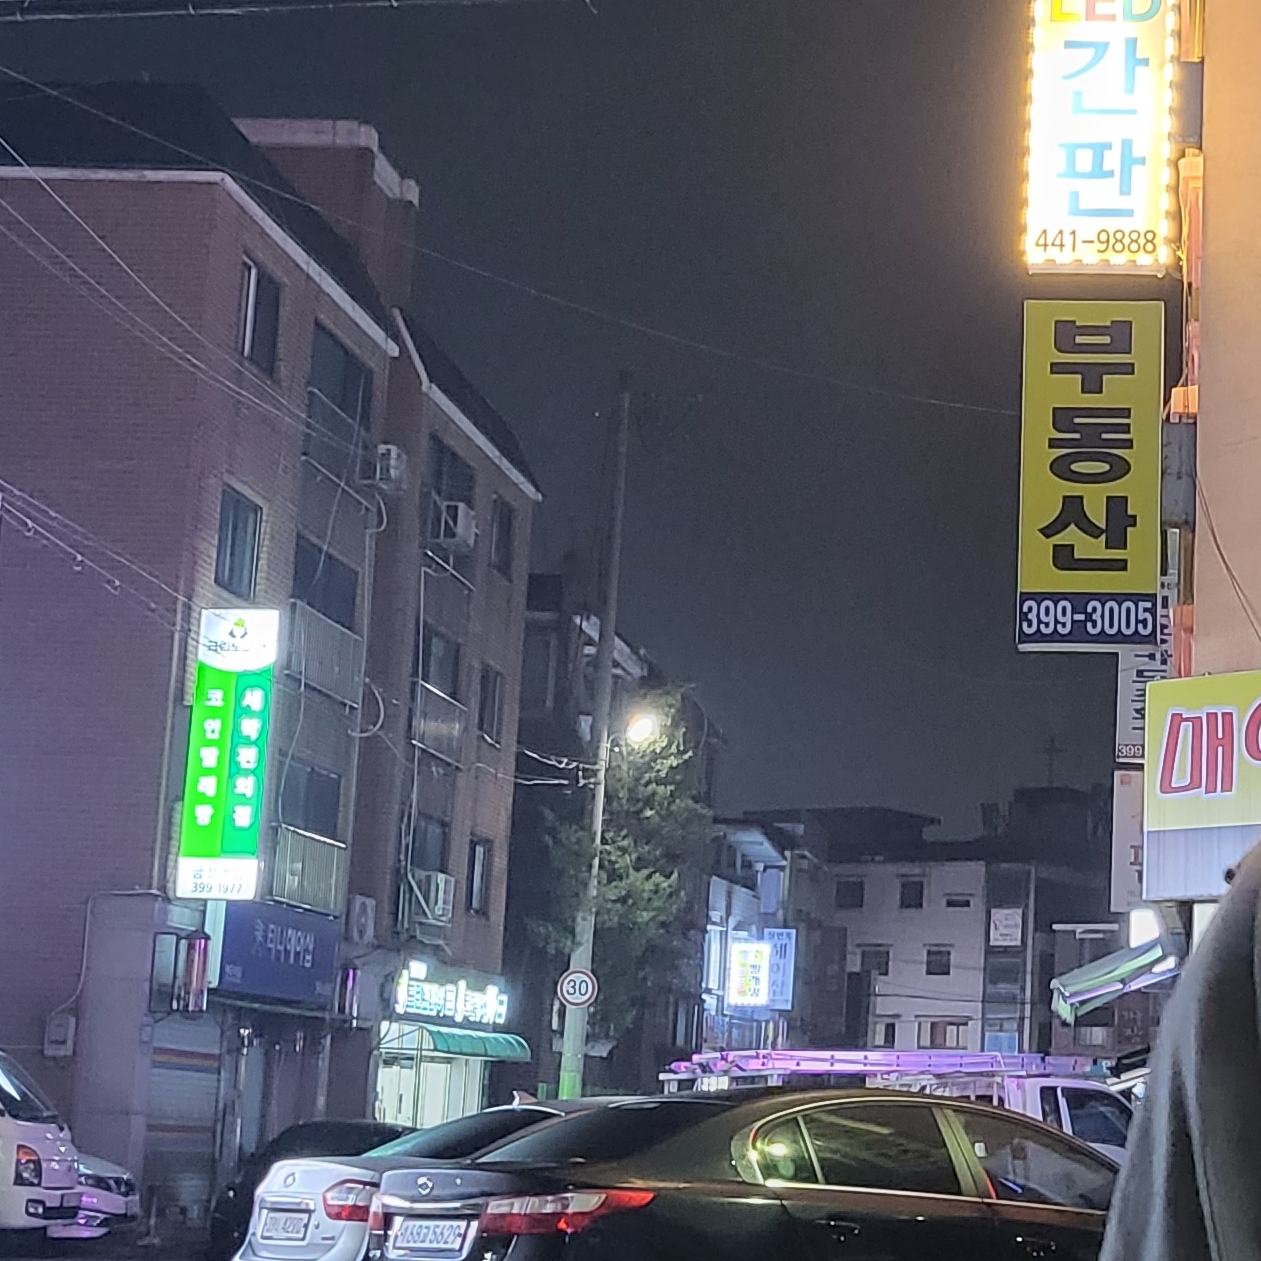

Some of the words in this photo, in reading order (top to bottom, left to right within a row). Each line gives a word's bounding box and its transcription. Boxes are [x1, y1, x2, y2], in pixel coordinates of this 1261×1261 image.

[1056, 37, 1149, 217] 간판
[1035, 228, 1156, 253] 441-9888
[1038, 320, 1137, 571] 부동산
[1021, 600, 1153, 636] 399-3005
[566, 977, 590, 998] 30
